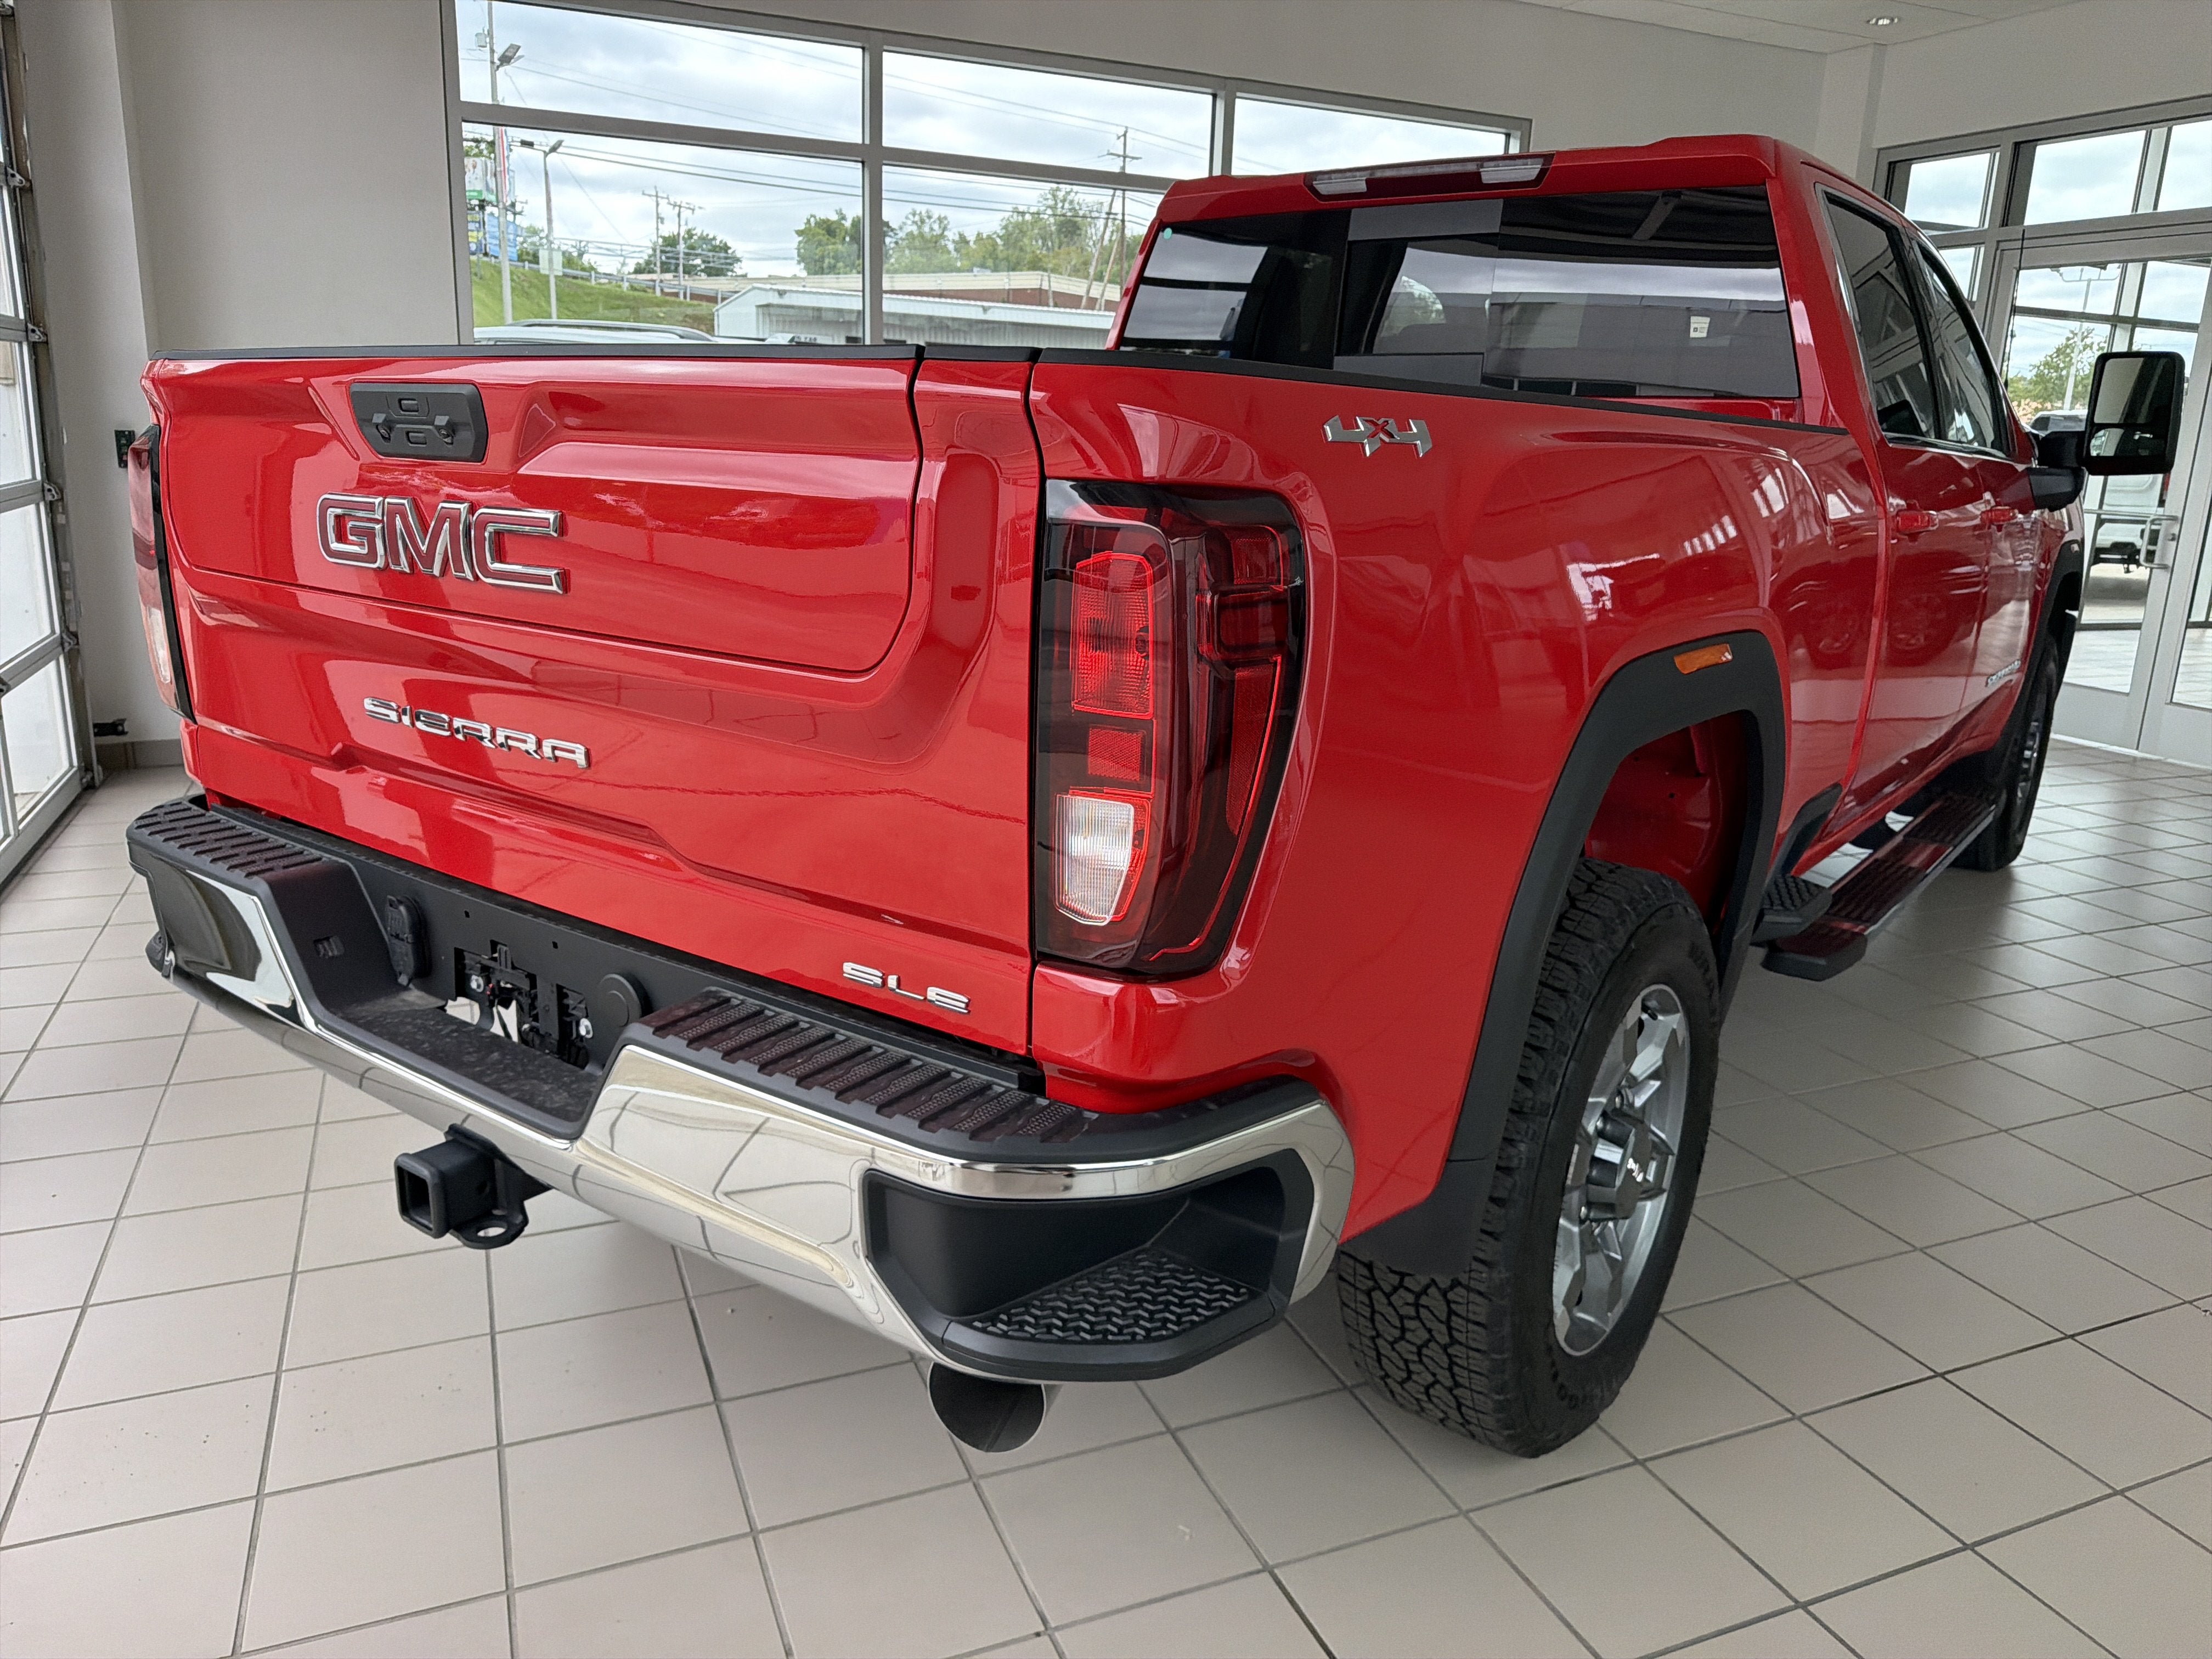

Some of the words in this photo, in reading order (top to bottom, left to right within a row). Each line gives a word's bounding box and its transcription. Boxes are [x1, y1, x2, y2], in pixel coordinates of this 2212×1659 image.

[317, 492, 571, 594] GMC
[363, 697, 591, 769] SIERRA
[843, 962, 971, 1014] SLE
